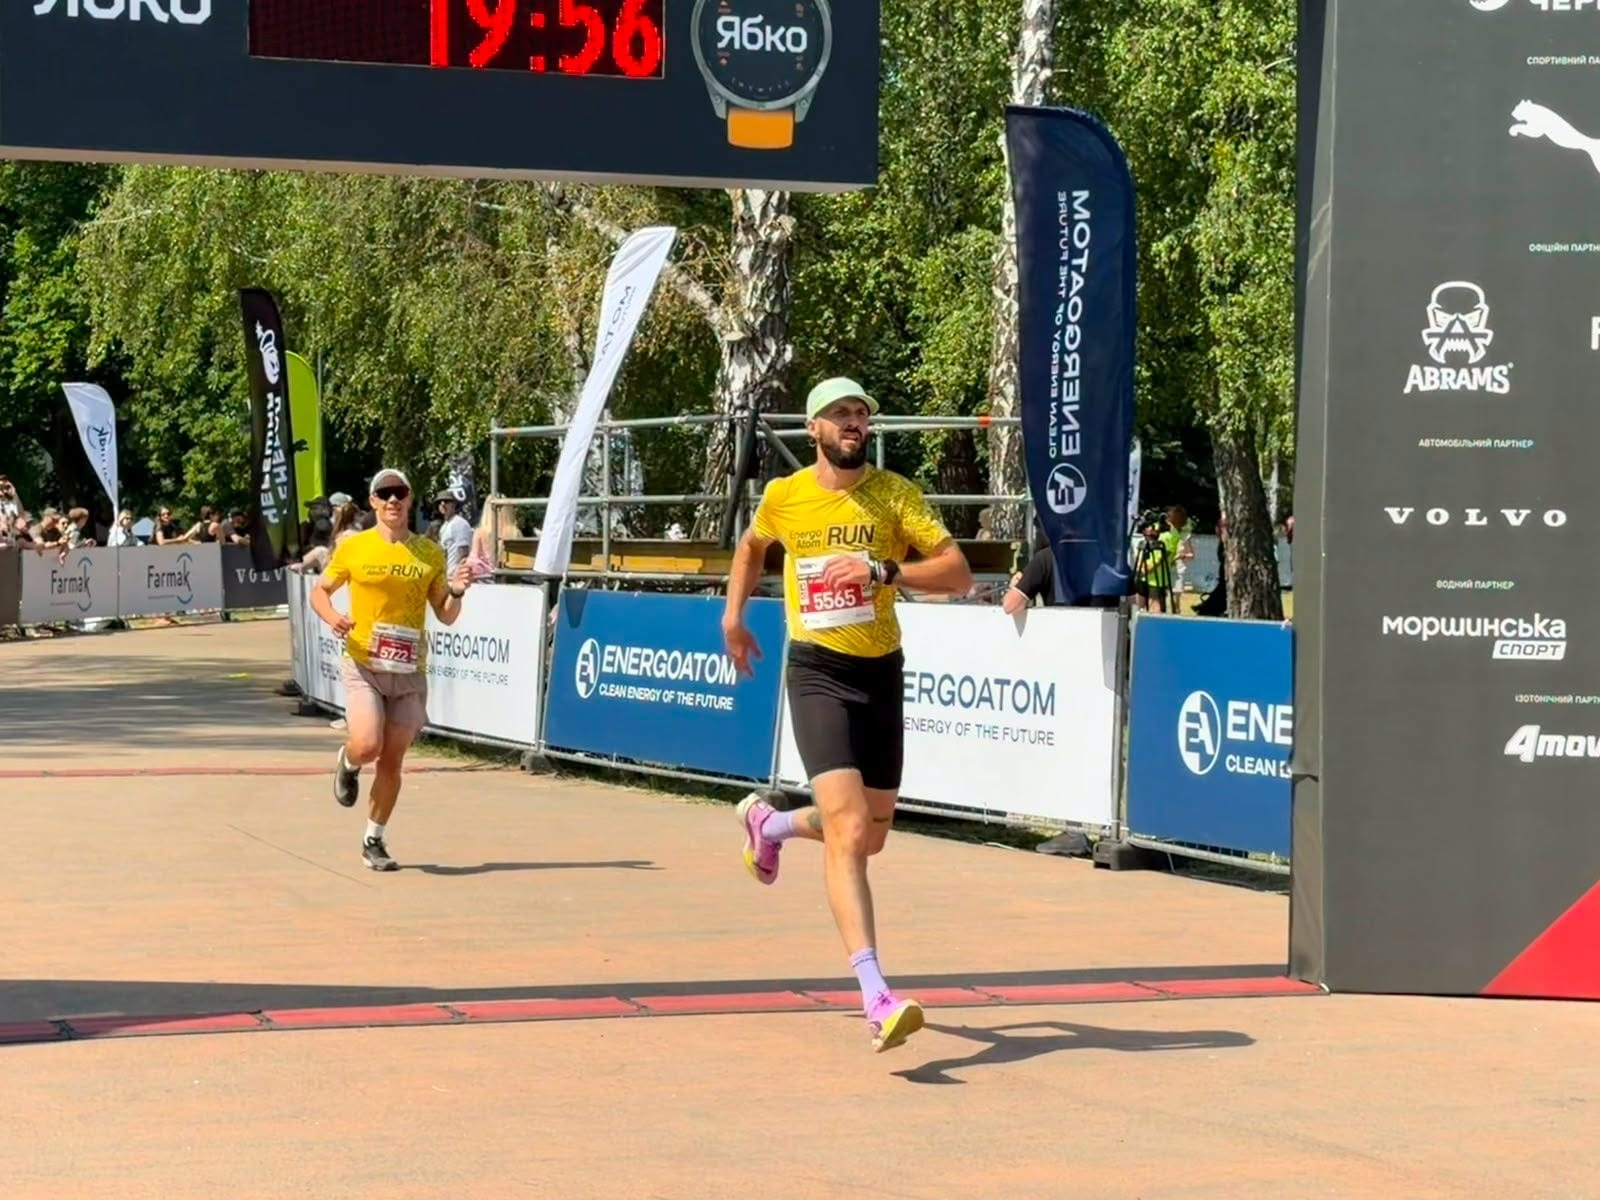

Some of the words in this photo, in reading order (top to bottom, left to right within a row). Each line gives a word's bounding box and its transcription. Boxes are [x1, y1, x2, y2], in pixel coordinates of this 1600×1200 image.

[429, 0, 661, 78] 19:56
[716, 14, 808, 53] Ябко
[1526, 54, 1586, 66] СПОРТИВНИЙ
[1403, 364, 1510, 394] ABRAMS
[1418, 438, 1493, 448] АВТОМОБІЛЬНИЙ
[1493, 439, 1534, 448] ПАРТНЕР
[1384, 507, 1567, 527] VOLVO
[790, 529, 822, 540] Energo
[827, 524, 876, 546] RUN
[51, 563, 91, 599] Farmak
[147, 560, 192, 592] Farmak
[236, 567, 286, 584] VOLV
[390, 564, 424, 578] RUN
[1436, 580, 1473, 590] ВОДНИЙ
[1474, 581, 1515, 590] ПАРТНЕР
[814, 589, 856, 610] 5565
[379, 646, 410, 663] 5722
[427, 630, 510, 664] NERGOATOM
[1499, 643, 1561, 657] СПОРТ
[602, 644, 737, 686] ENERGOATOM
[599, 683, 626, 698] CLEAN
[627, 687, 661, 704] ENERGY
[662, 690, 675, 703] OF
[676, 692, 695, 707] THE
[695, 695, 734, 711] FUTURE
[902, 671, 1056, 716] ERGOATOM
[903, 716, 951, 735] ENERGY
[954, 721, 971, 737] OF
[975, 723, 999, 740] THE
[1002, 727, 1055, 746] FUTURE
[1226, 700, 1293, 746] ENE
[1225, 754, 1277, 777] CLEAN
